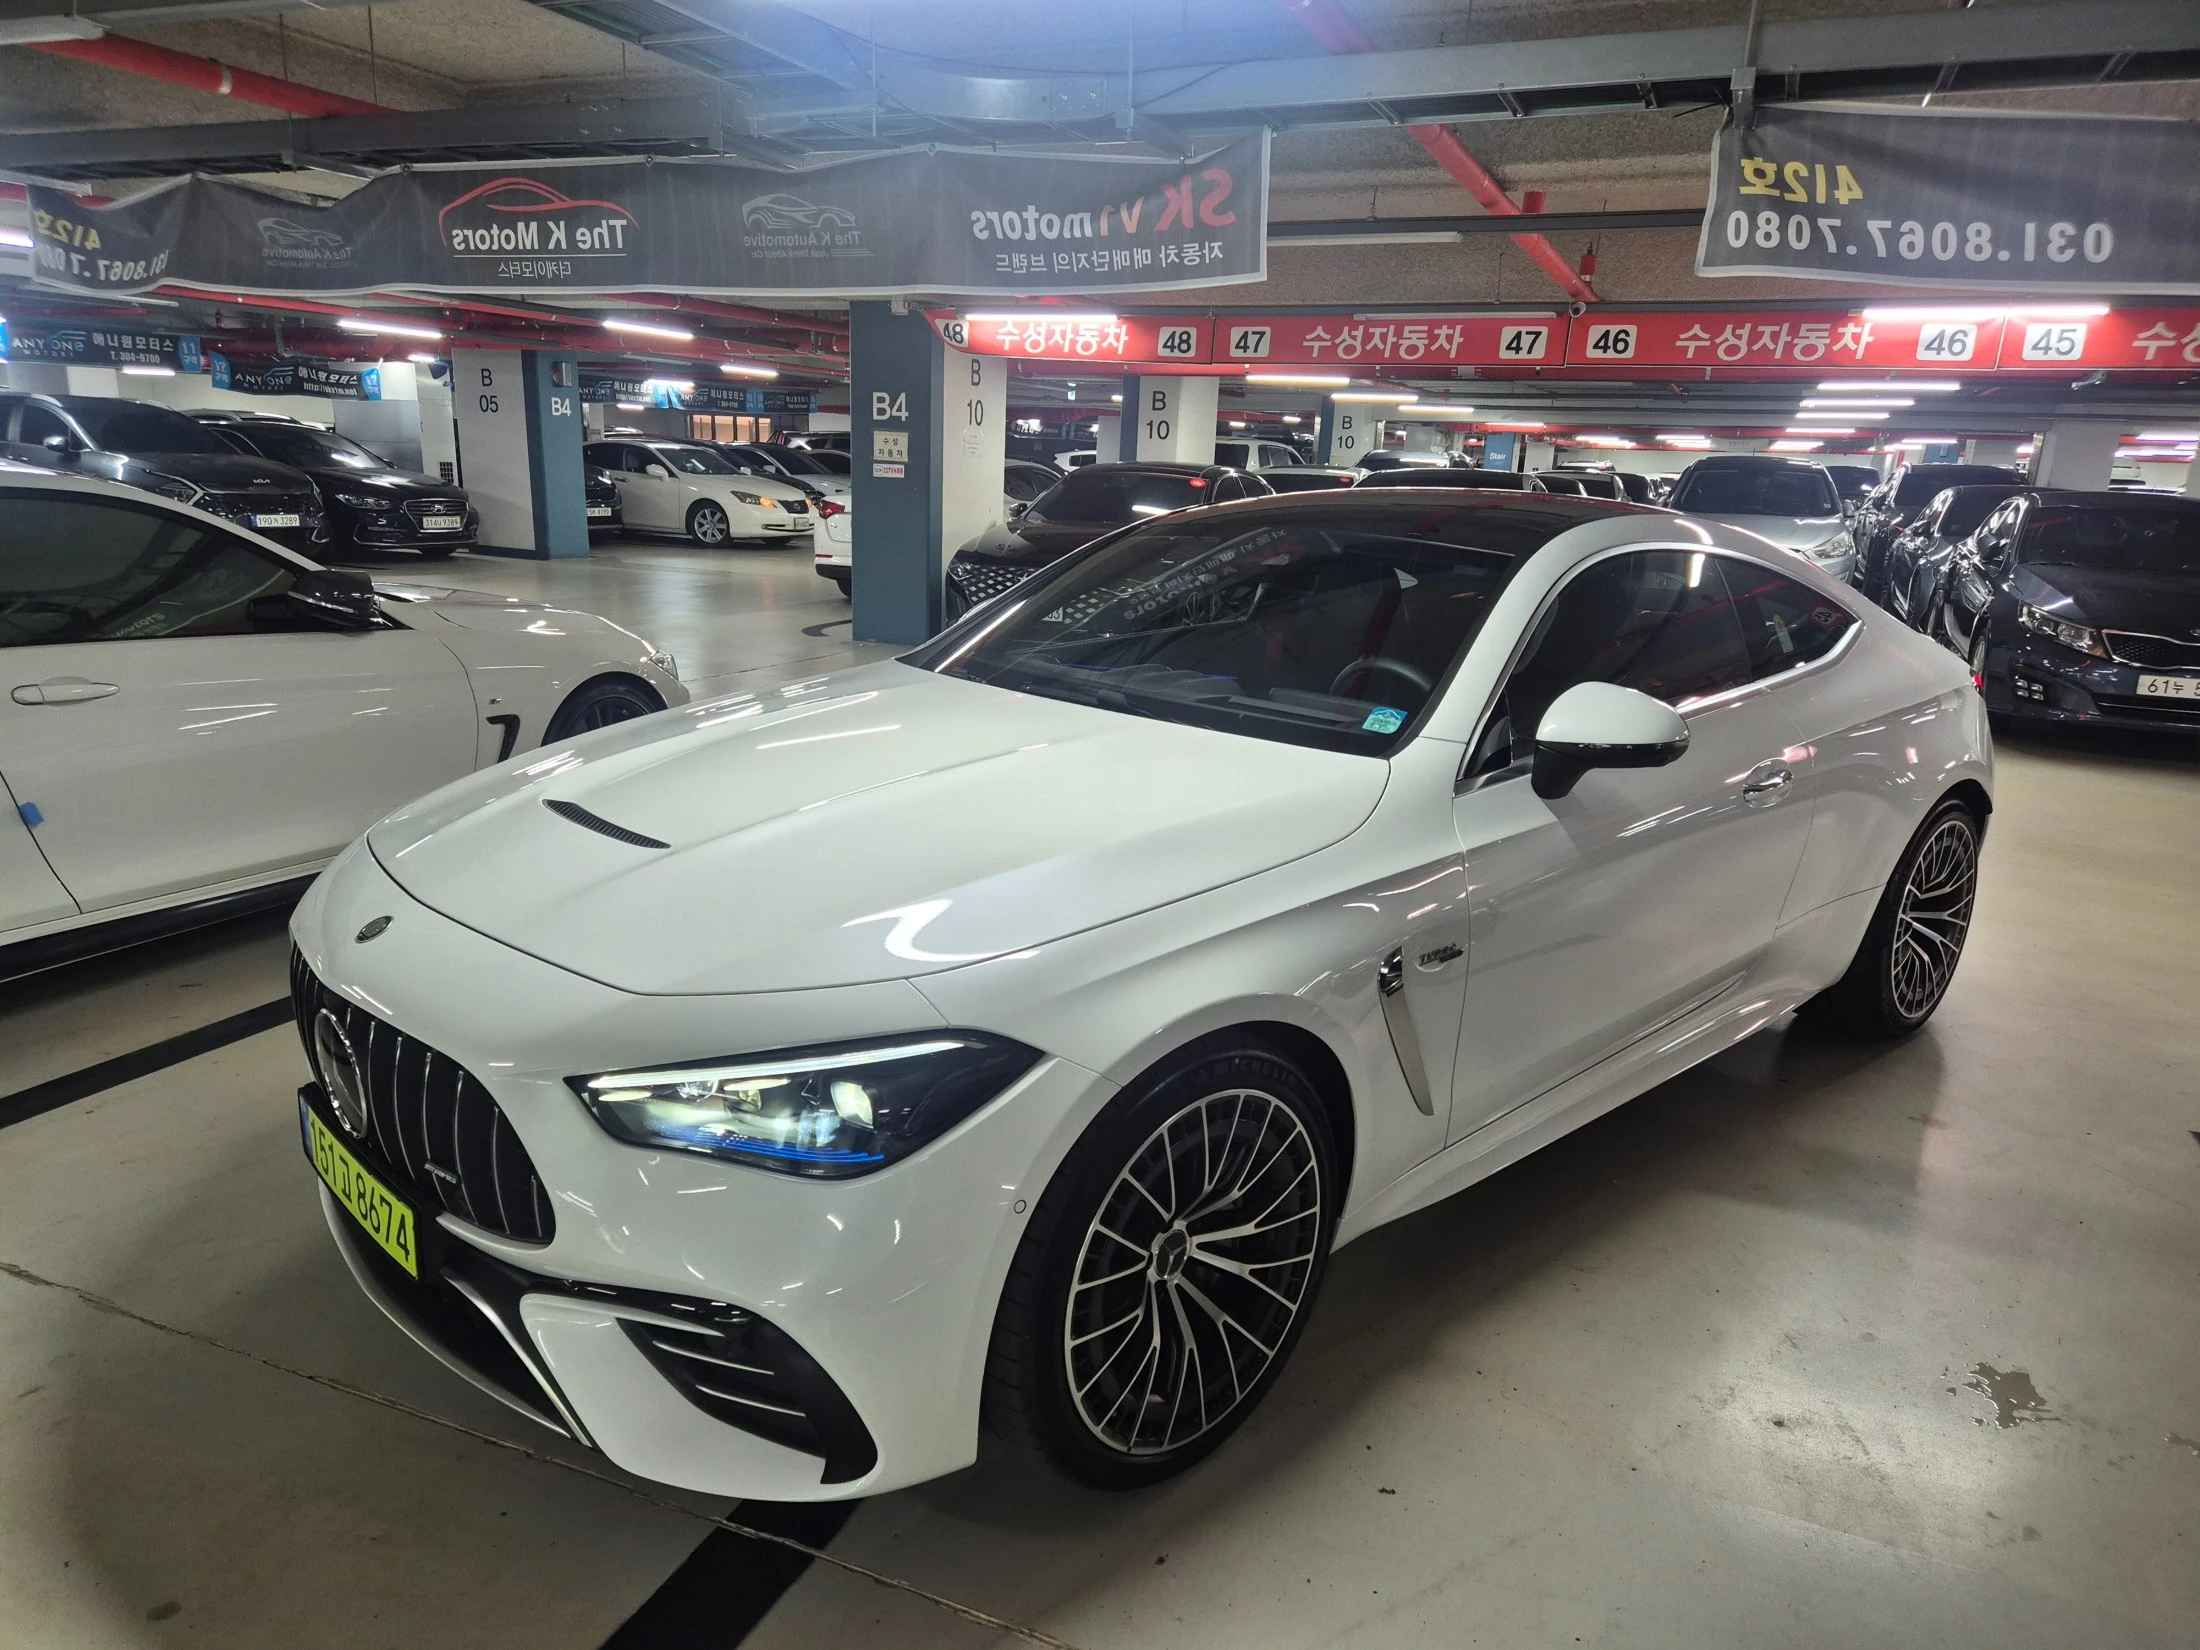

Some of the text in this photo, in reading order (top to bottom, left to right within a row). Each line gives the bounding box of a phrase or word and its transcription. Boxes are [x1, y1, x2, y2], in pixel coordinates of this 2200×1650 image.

[11, 337, 46, 349] ANY
[92, 332, 174, 351] 애니원모터스
[943, 320, 1193, 355] 48 수성자동차 48
[1234, 324, 1543, 360] 47 수성자동차 47
[1592, 322, 1969, 361] 46 수성자동차 46
[2031, 328, 2078, 356] 45
[235, 372, 262, 386] ANY
[481, 368, 493, 387] B
[971, 359, 981, 386] B
[479, 395, 499, 413] 05
[551, 397, 572, 416] B4
[873, 392, 909, 421] B4
[1152, 391, 1166, 411] B
[967, 399, 984, 426] 10
[1146, 420, 1170, 440] 10
[1342, 416, 1353, 429] B
[1338, 435, 1355, 449] 10
[280, 516, 298, 526] 3289
[2147, 678, 2185, 696] 61누
[356, 1172, 410, 1263] 8674
